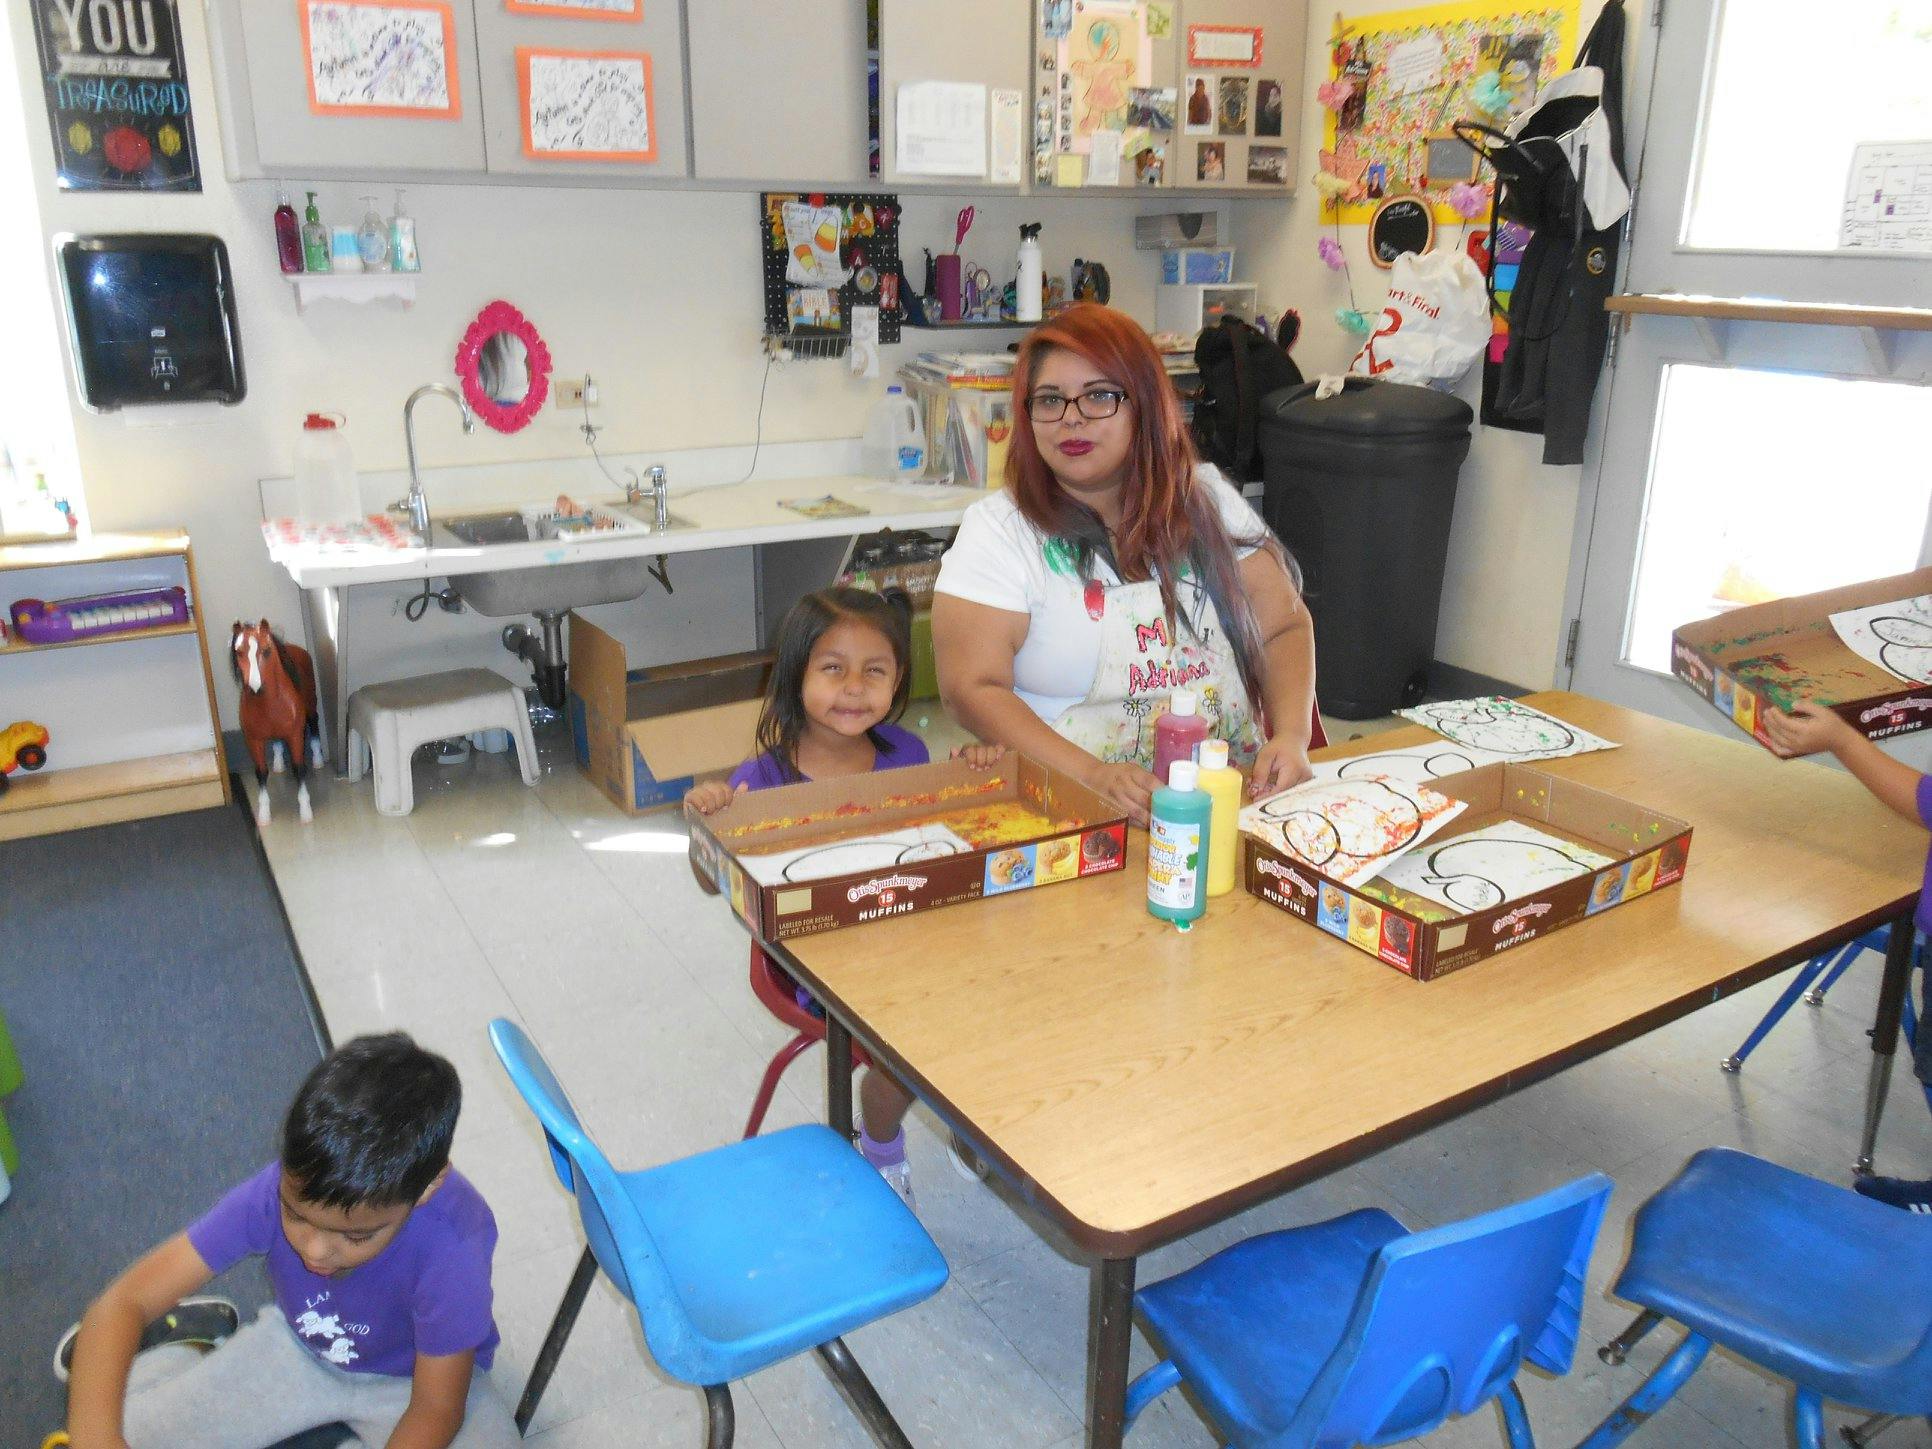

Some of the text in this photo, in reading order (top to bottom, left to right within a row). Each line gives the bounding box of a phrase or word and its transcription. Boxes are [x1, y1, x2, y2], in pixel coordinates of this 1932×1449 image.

[56, 0, 156, 55] YOU
[1129, 659, 1210, 696] Adriana
[1891, 713, 1904, 723] 15
[1868, 720, 1922, 738] MUFFINS
[847, 874, 928, 903] Otis Spunkmeyer
[1280, 881, 1290, 894] 15
[880, 893, 894, 904] 15
[1263, 887, 1307, 916] MUFFINS
[858, 901, 914, 922] MUFFINS
[779, 919, 803, 930] LABELED
[814, 914, 834, 924] RESALE
[1514, 921, 1525, 932] 15
[779, 929, 790, 937] NET
[1494, 928, 1537, 951] MUFFINS
